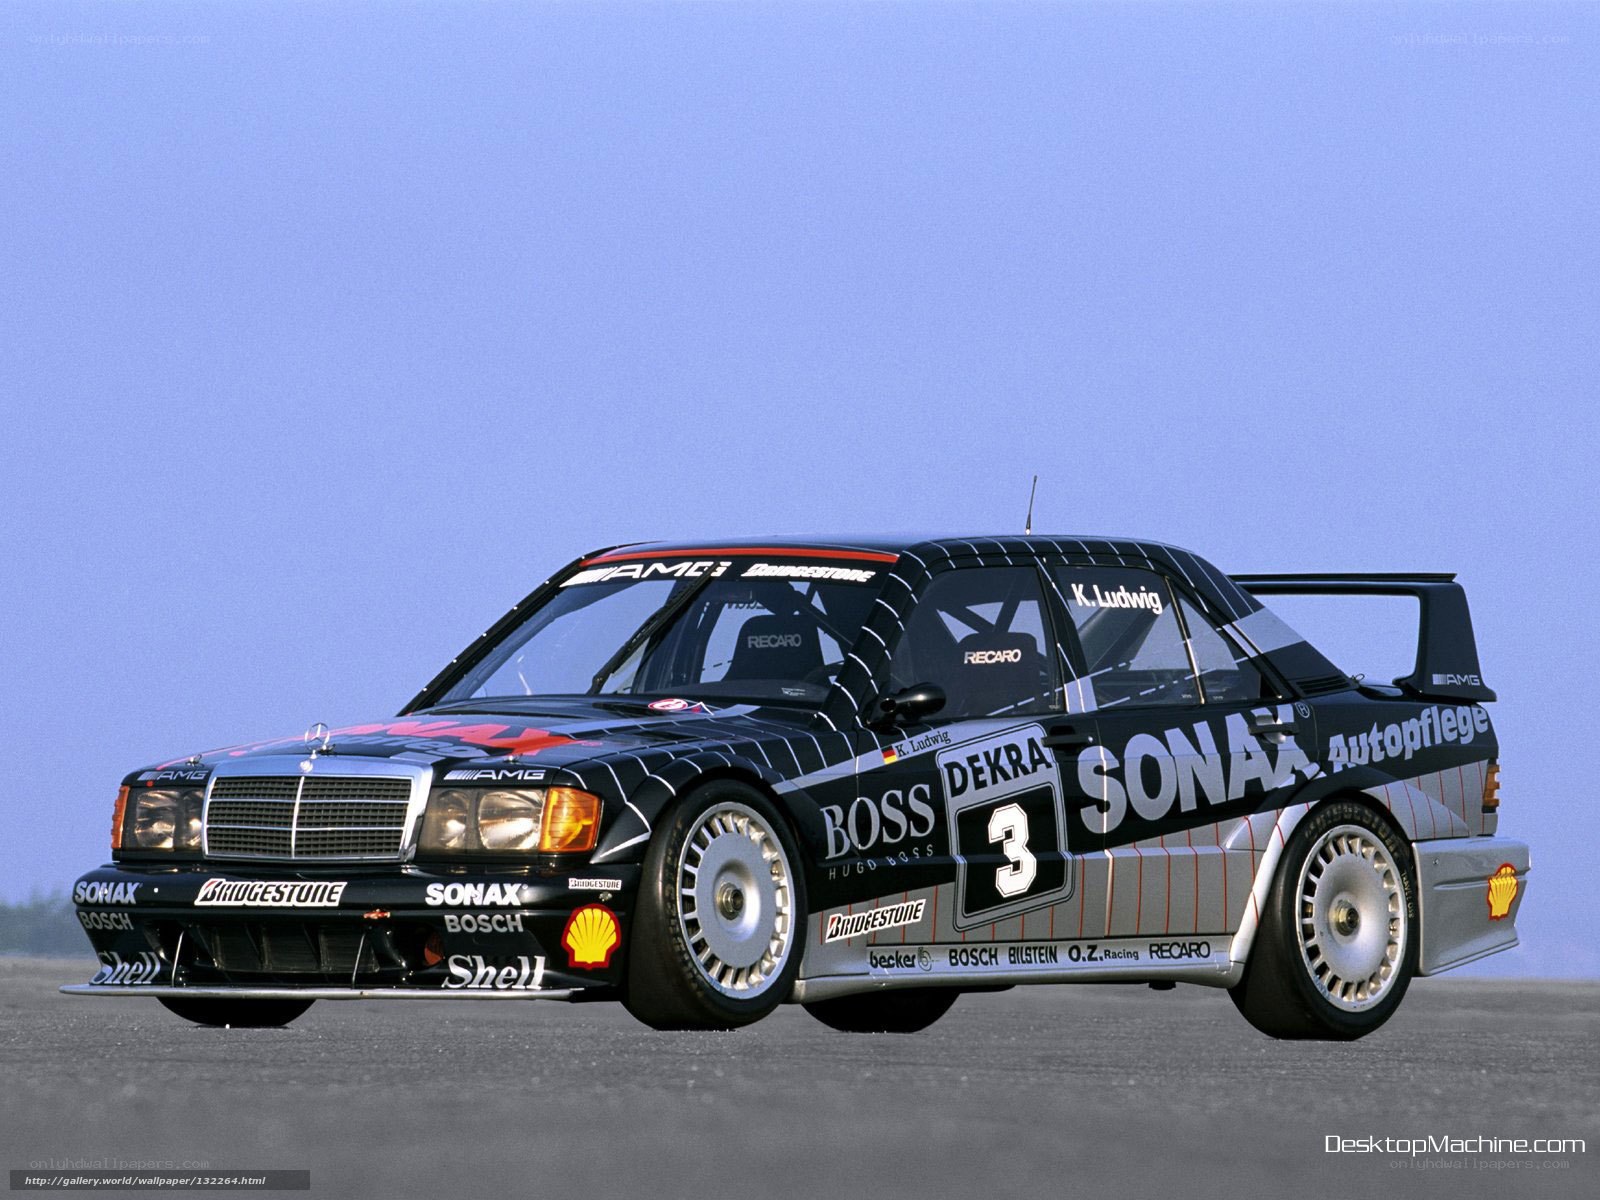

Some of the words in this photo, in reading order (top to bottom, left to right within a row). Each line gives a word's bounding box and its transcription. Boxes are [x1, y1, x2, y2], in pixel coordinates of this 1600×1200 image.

[741, 563, 876, 583] BRIDGESTONE
[747, 633, 802, 649] RECARO
[964, 649, 1022, 665] RECARO
[1446, 674, 1481, 686] AMG
[911, 730, 951, 753] Ludwig
[1328, 704, 1489, 774] Autopflege
[155, 771, 209, 780] AMG
[473, 769, 546, 780] AMG
[943, 736, 1053, 798] DEKRA
[1077, 703, 1328, 835] SONAX
[819, 783, 936, 860] BOSS
[987, 802, 1037, 898] 3
[828, 859, 877, 880] HUGO
[889, 844, 934, 867] BOSS
[74, 881, 137, 905] SONAX
[198, 880, 344, 904] BRIDGESTONE
[425, 883, 524, 906] SONAX
[569, 879, 621, 889] BRIDGESTONE
[79, 911, 134, 931] BOSCH
[444, 914, 524, 933] BOSCH
[826, 901, 925, 940] BRIDGESTONE
[869, 950, 916, 969] becker
[949, 947, 999, 967] BOSCH
[1008, 945, 1058, 965] BILSTEIN
[1149, 941, 1211, 960] RECARO
[90, 951, 161, 985] Shell
[441, 954, 545, 990] Shell
